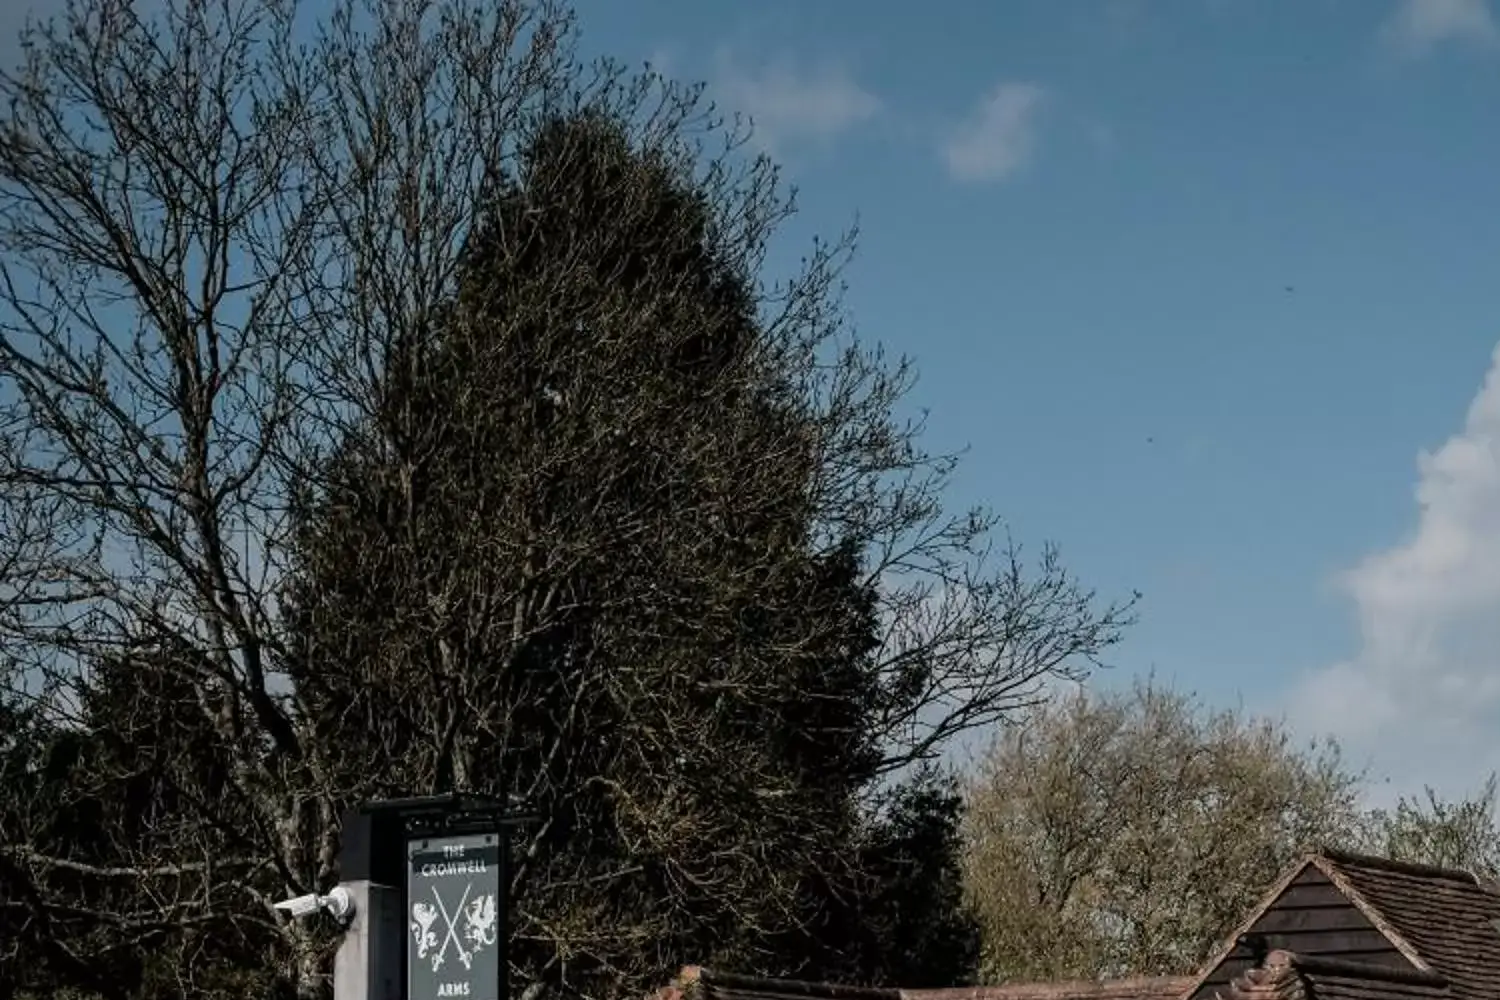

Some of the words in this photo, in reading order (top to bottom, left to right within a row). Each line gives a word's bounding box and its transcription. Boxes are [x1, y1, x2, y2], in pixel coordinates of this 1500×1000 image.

[442, 844, 465, 858] THE
[421, 859, 488, 877] CROMWELL
[437, 981, 471, 997] ARMS
